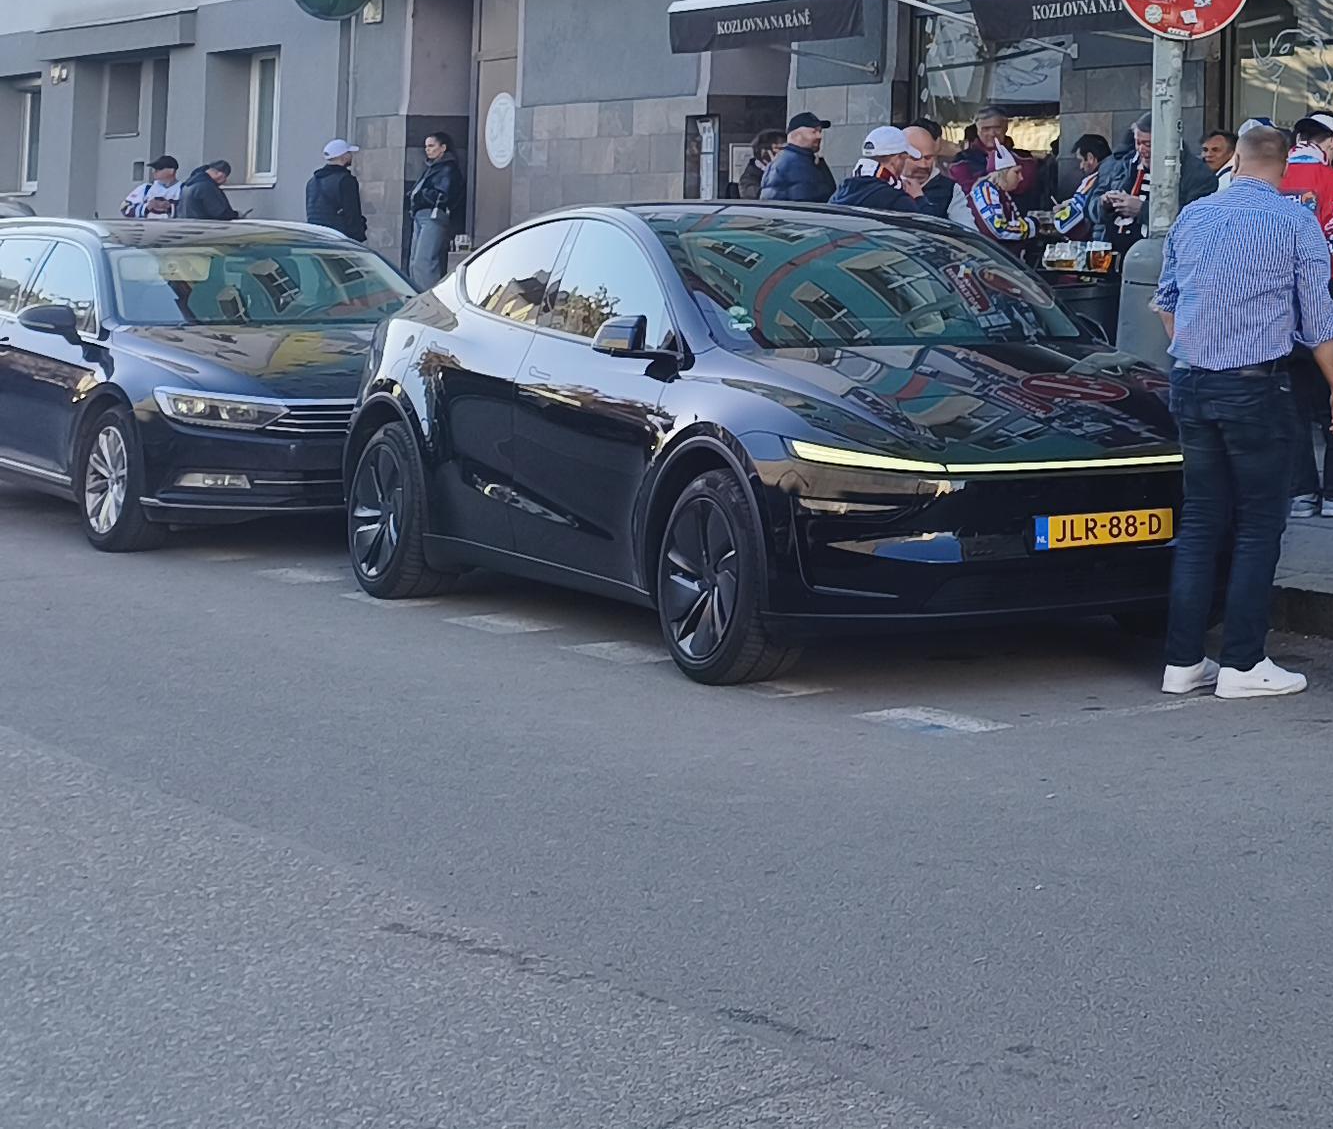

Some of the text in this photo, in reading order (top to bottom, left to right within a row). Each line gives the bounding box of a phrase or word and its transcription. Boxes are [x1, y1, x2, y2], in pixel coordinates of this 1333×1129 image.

[717, 8, 812, 35] KOZLOVNA NA RÁNĚ
[1032, 0, 1097, 20] KOZLOVNA
[1036, 513, 1162, 543] NL JLR-88-D
